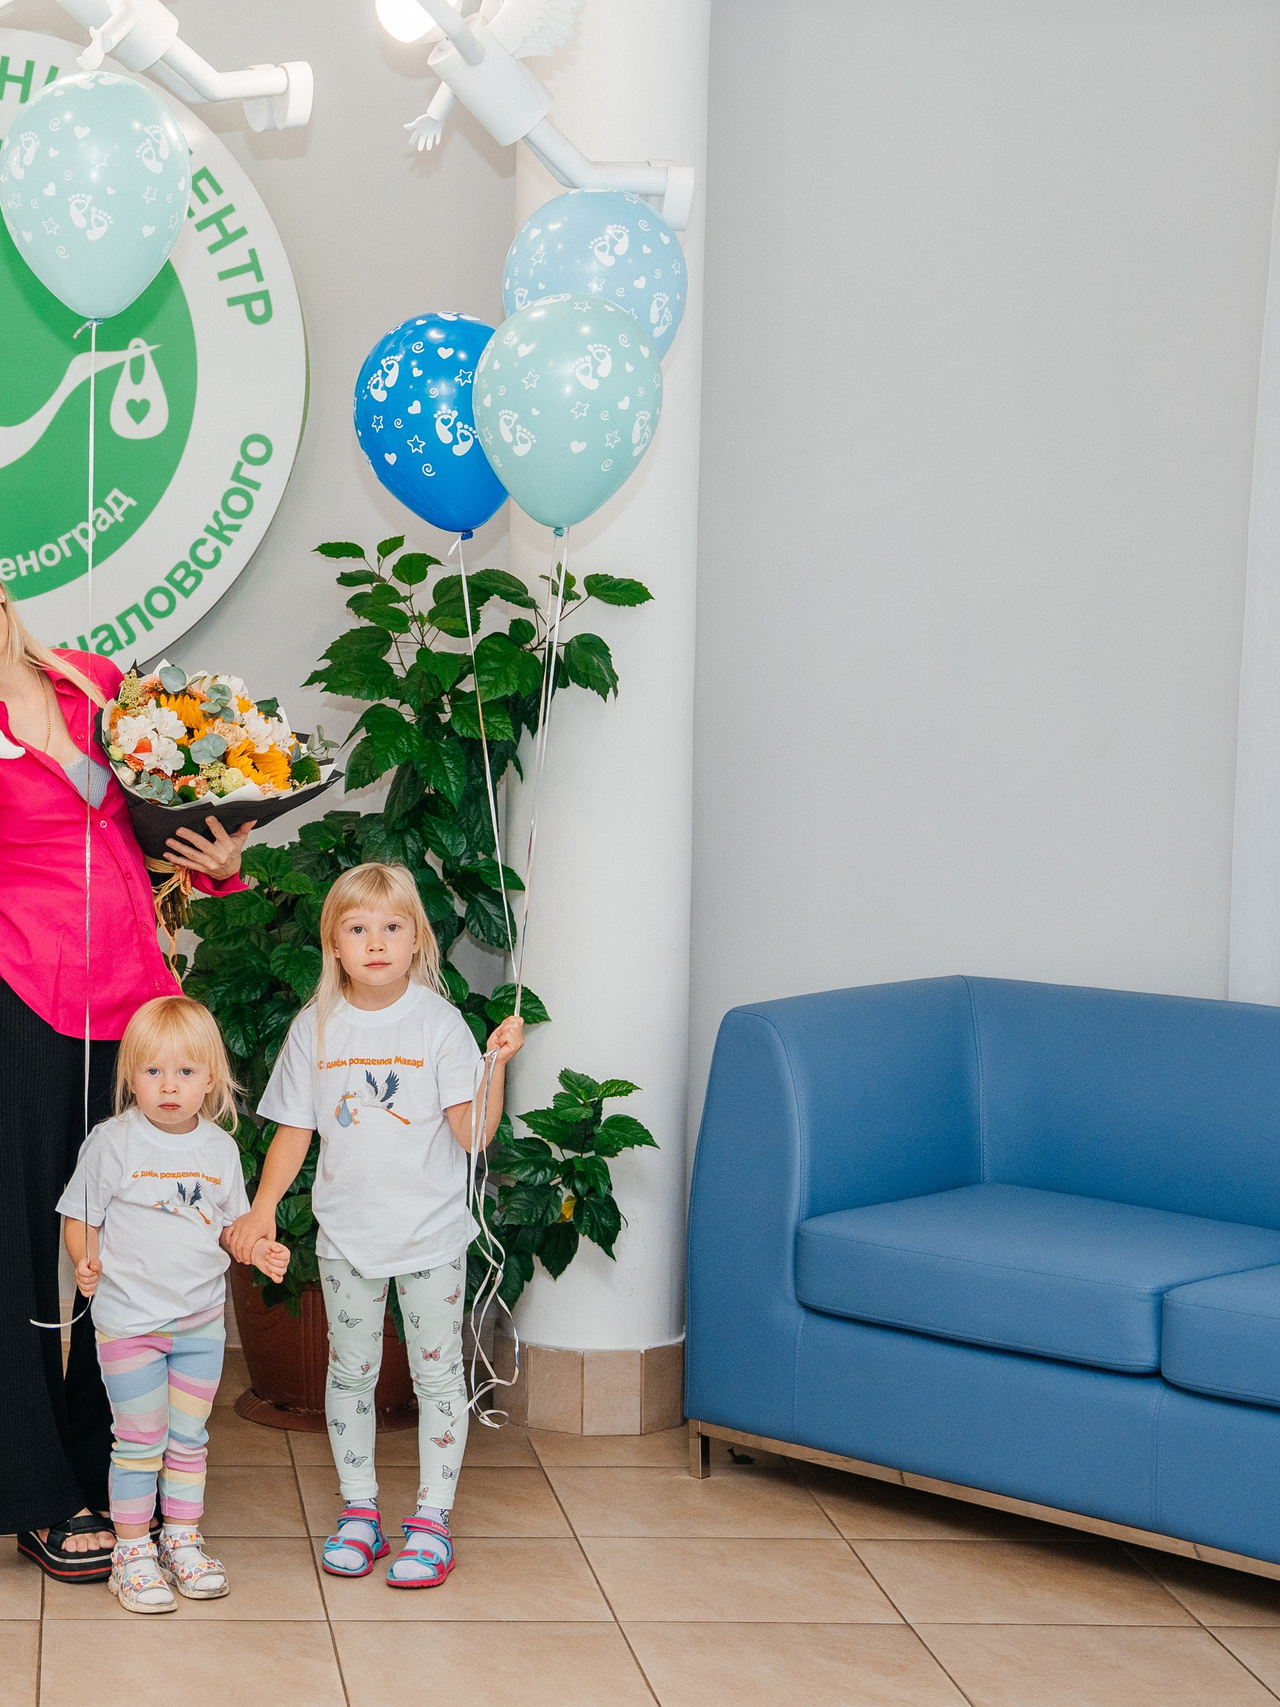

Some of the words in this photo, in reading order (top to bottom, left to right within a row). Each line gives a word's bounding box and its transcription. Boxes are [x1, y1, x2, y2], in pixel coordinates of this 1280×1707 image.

[187, 148, 274, 326] ЕНТР
[56, 433, 274, 657] аловского
[317, 1060, 325, 1070] С
[326, 1058, 347, 1069] днём
[348, 1057, 392, 1067] рождения
[393, 1055, 424, 1068] Макар!
